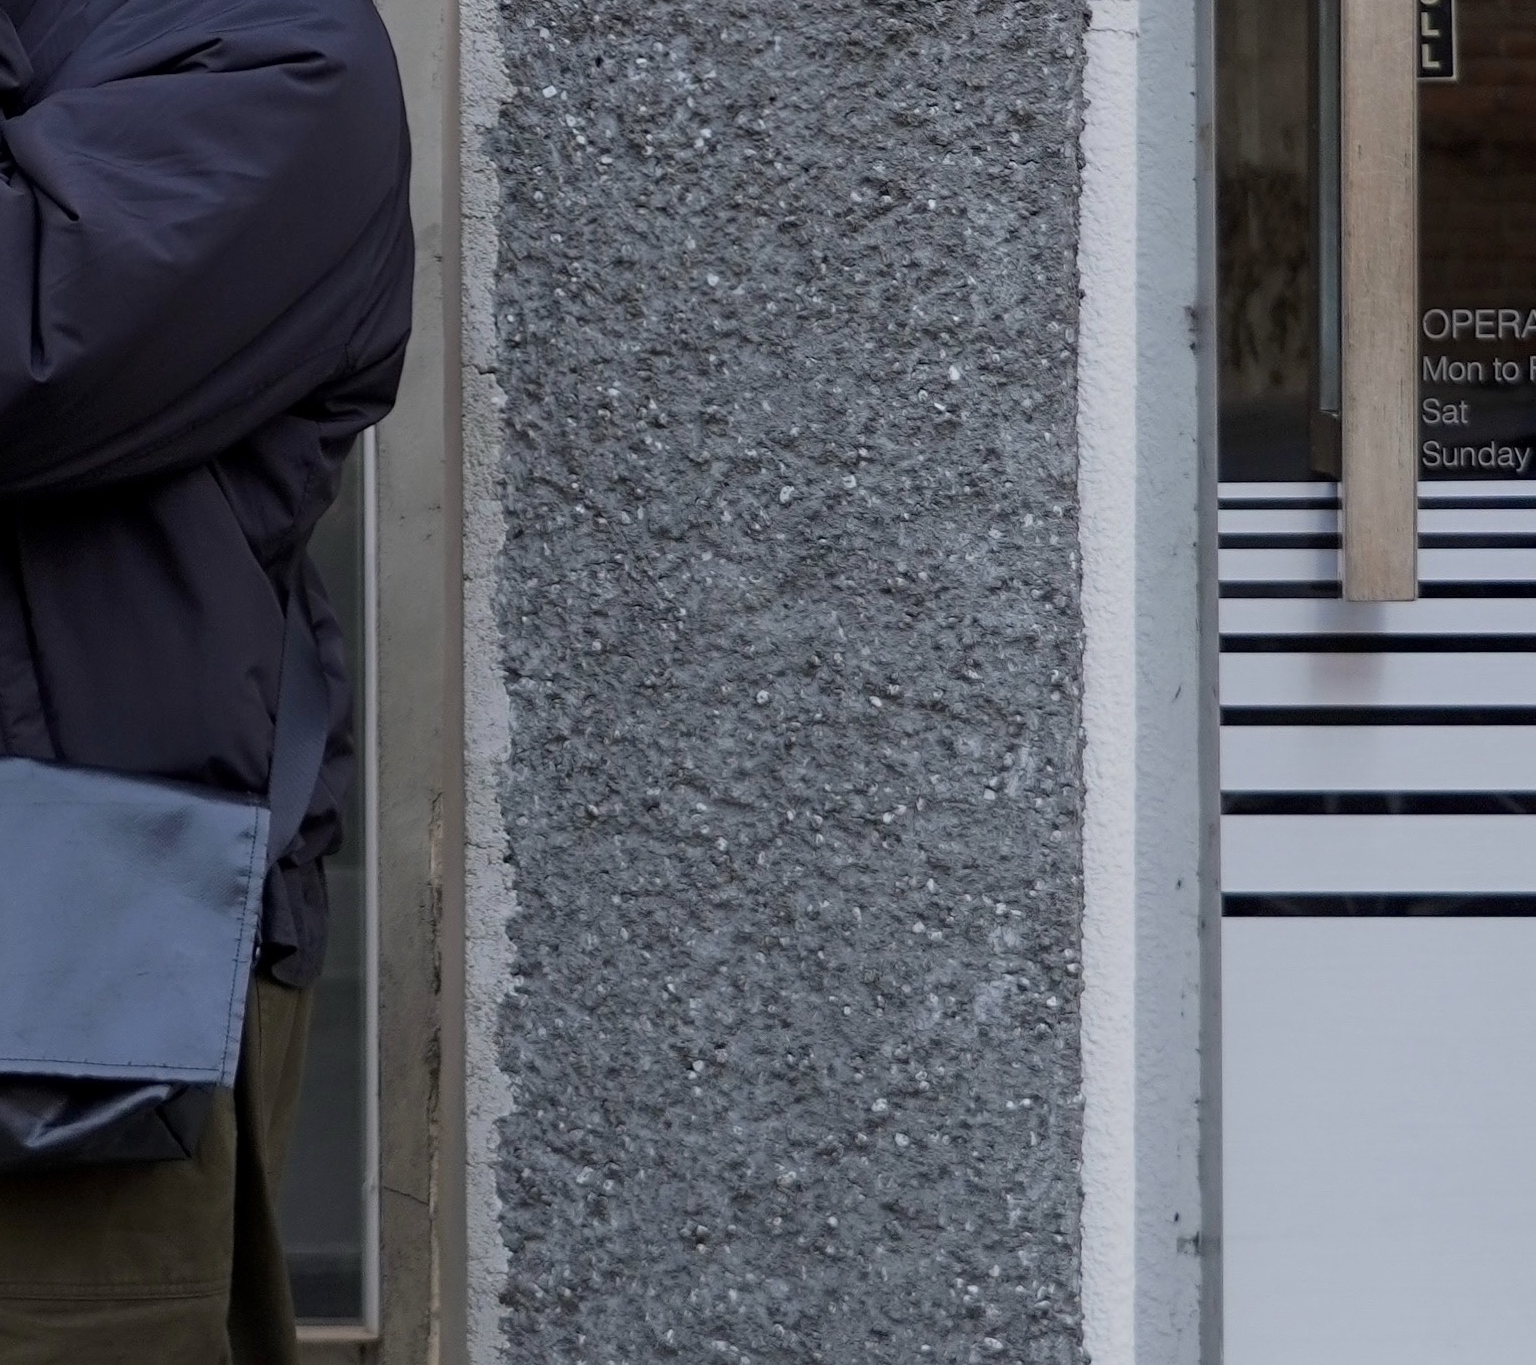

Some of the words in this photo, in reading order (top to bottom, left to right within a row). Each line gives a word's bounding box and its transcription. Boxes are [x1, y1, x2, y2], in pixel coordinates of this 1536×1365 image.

[1422, 355, 1483, 381] Mon
[1492, 357, 1520, 381] to
[1422, 397, 1469, 424] Sat
[1422, 440, 1531, 473] Sunday
